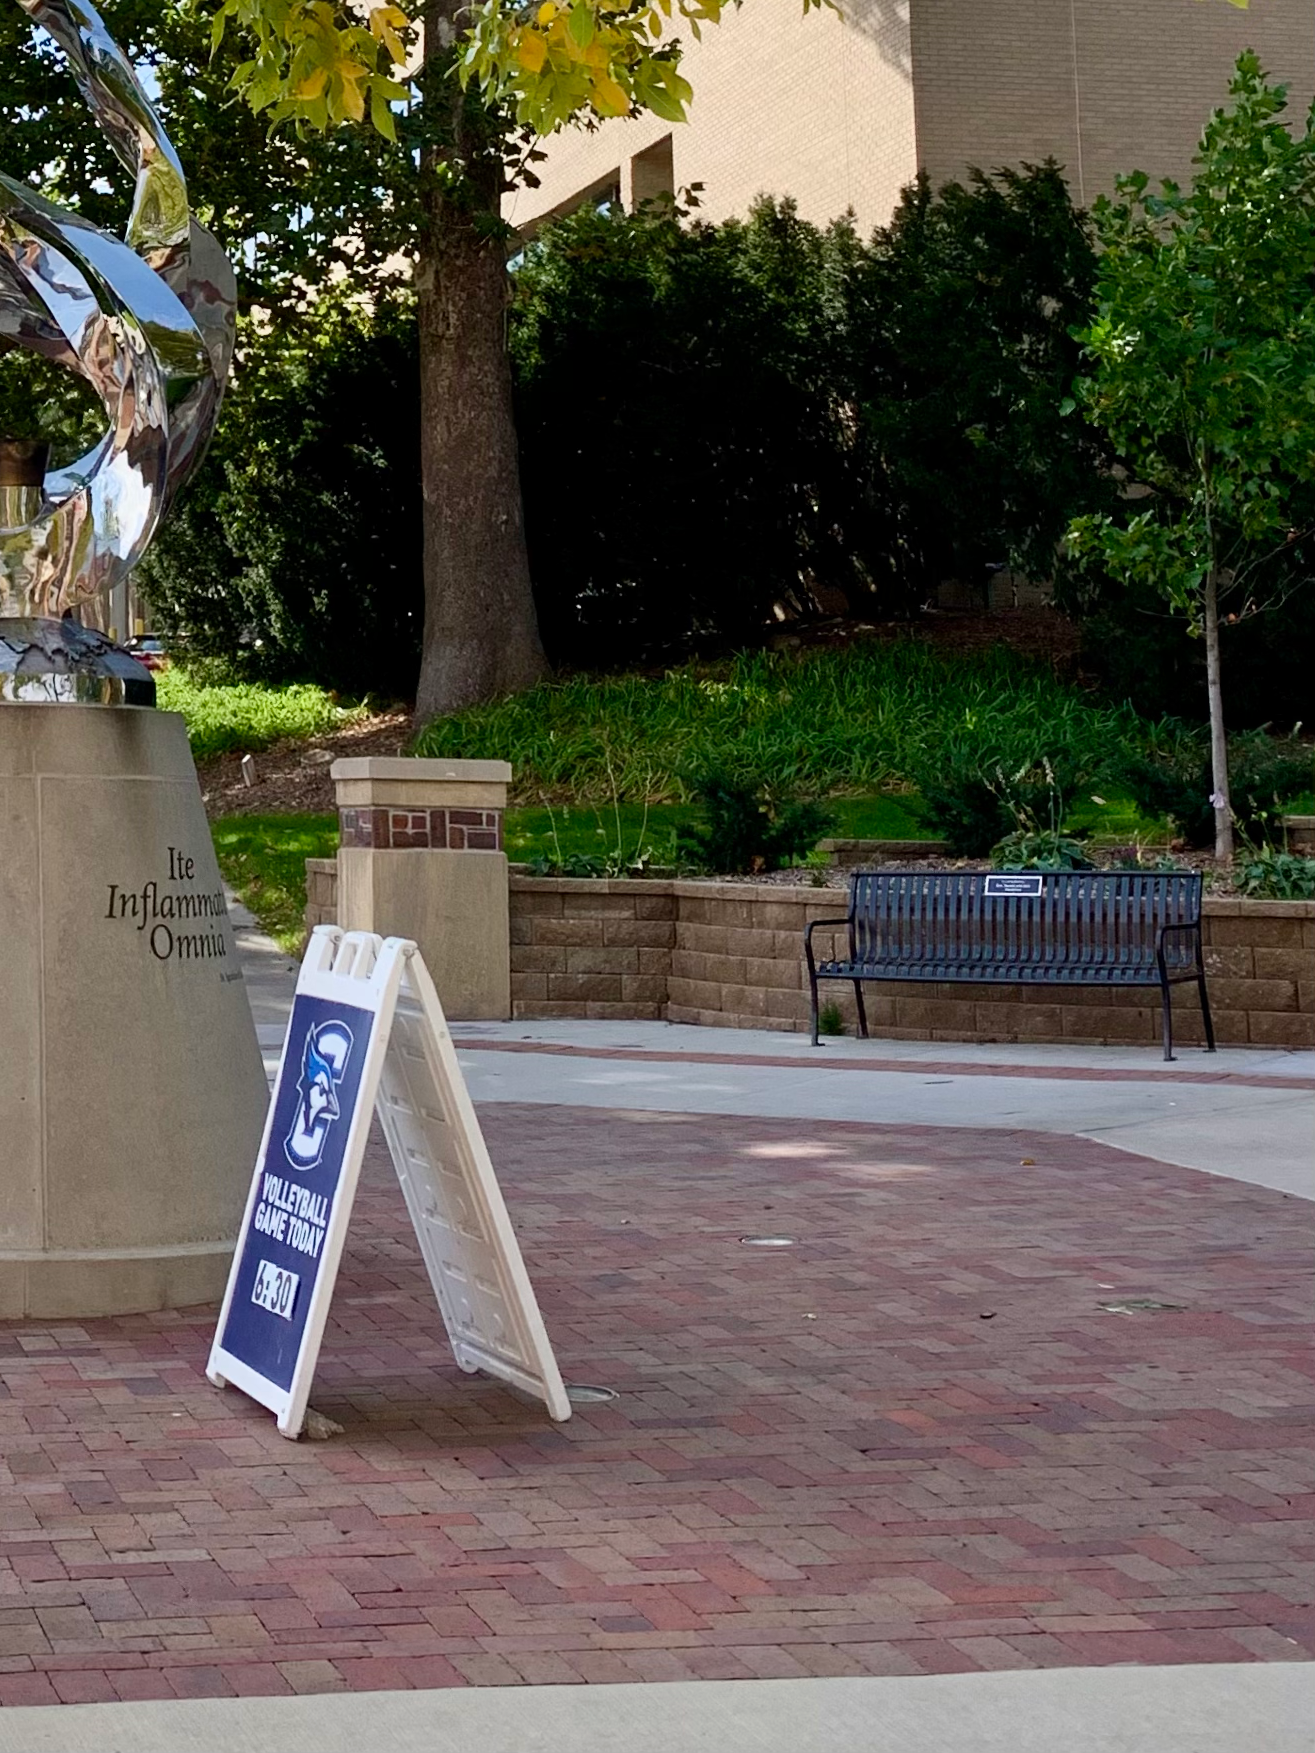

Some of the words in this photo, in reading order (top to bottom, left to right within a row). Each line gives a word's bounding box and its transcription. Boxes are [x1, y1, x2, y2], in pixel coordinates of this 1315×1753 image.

[167, 847, 195, 880] Ite
[150, 923, 226, 960] Omnia
[262, 1172, 328, 1228] VOLLEYBALL
[254, 1202, 288, 1242] GAME
[286, 1214, 324, 1258] TODAY
[254, 1262, 292, 1314] 6:30
